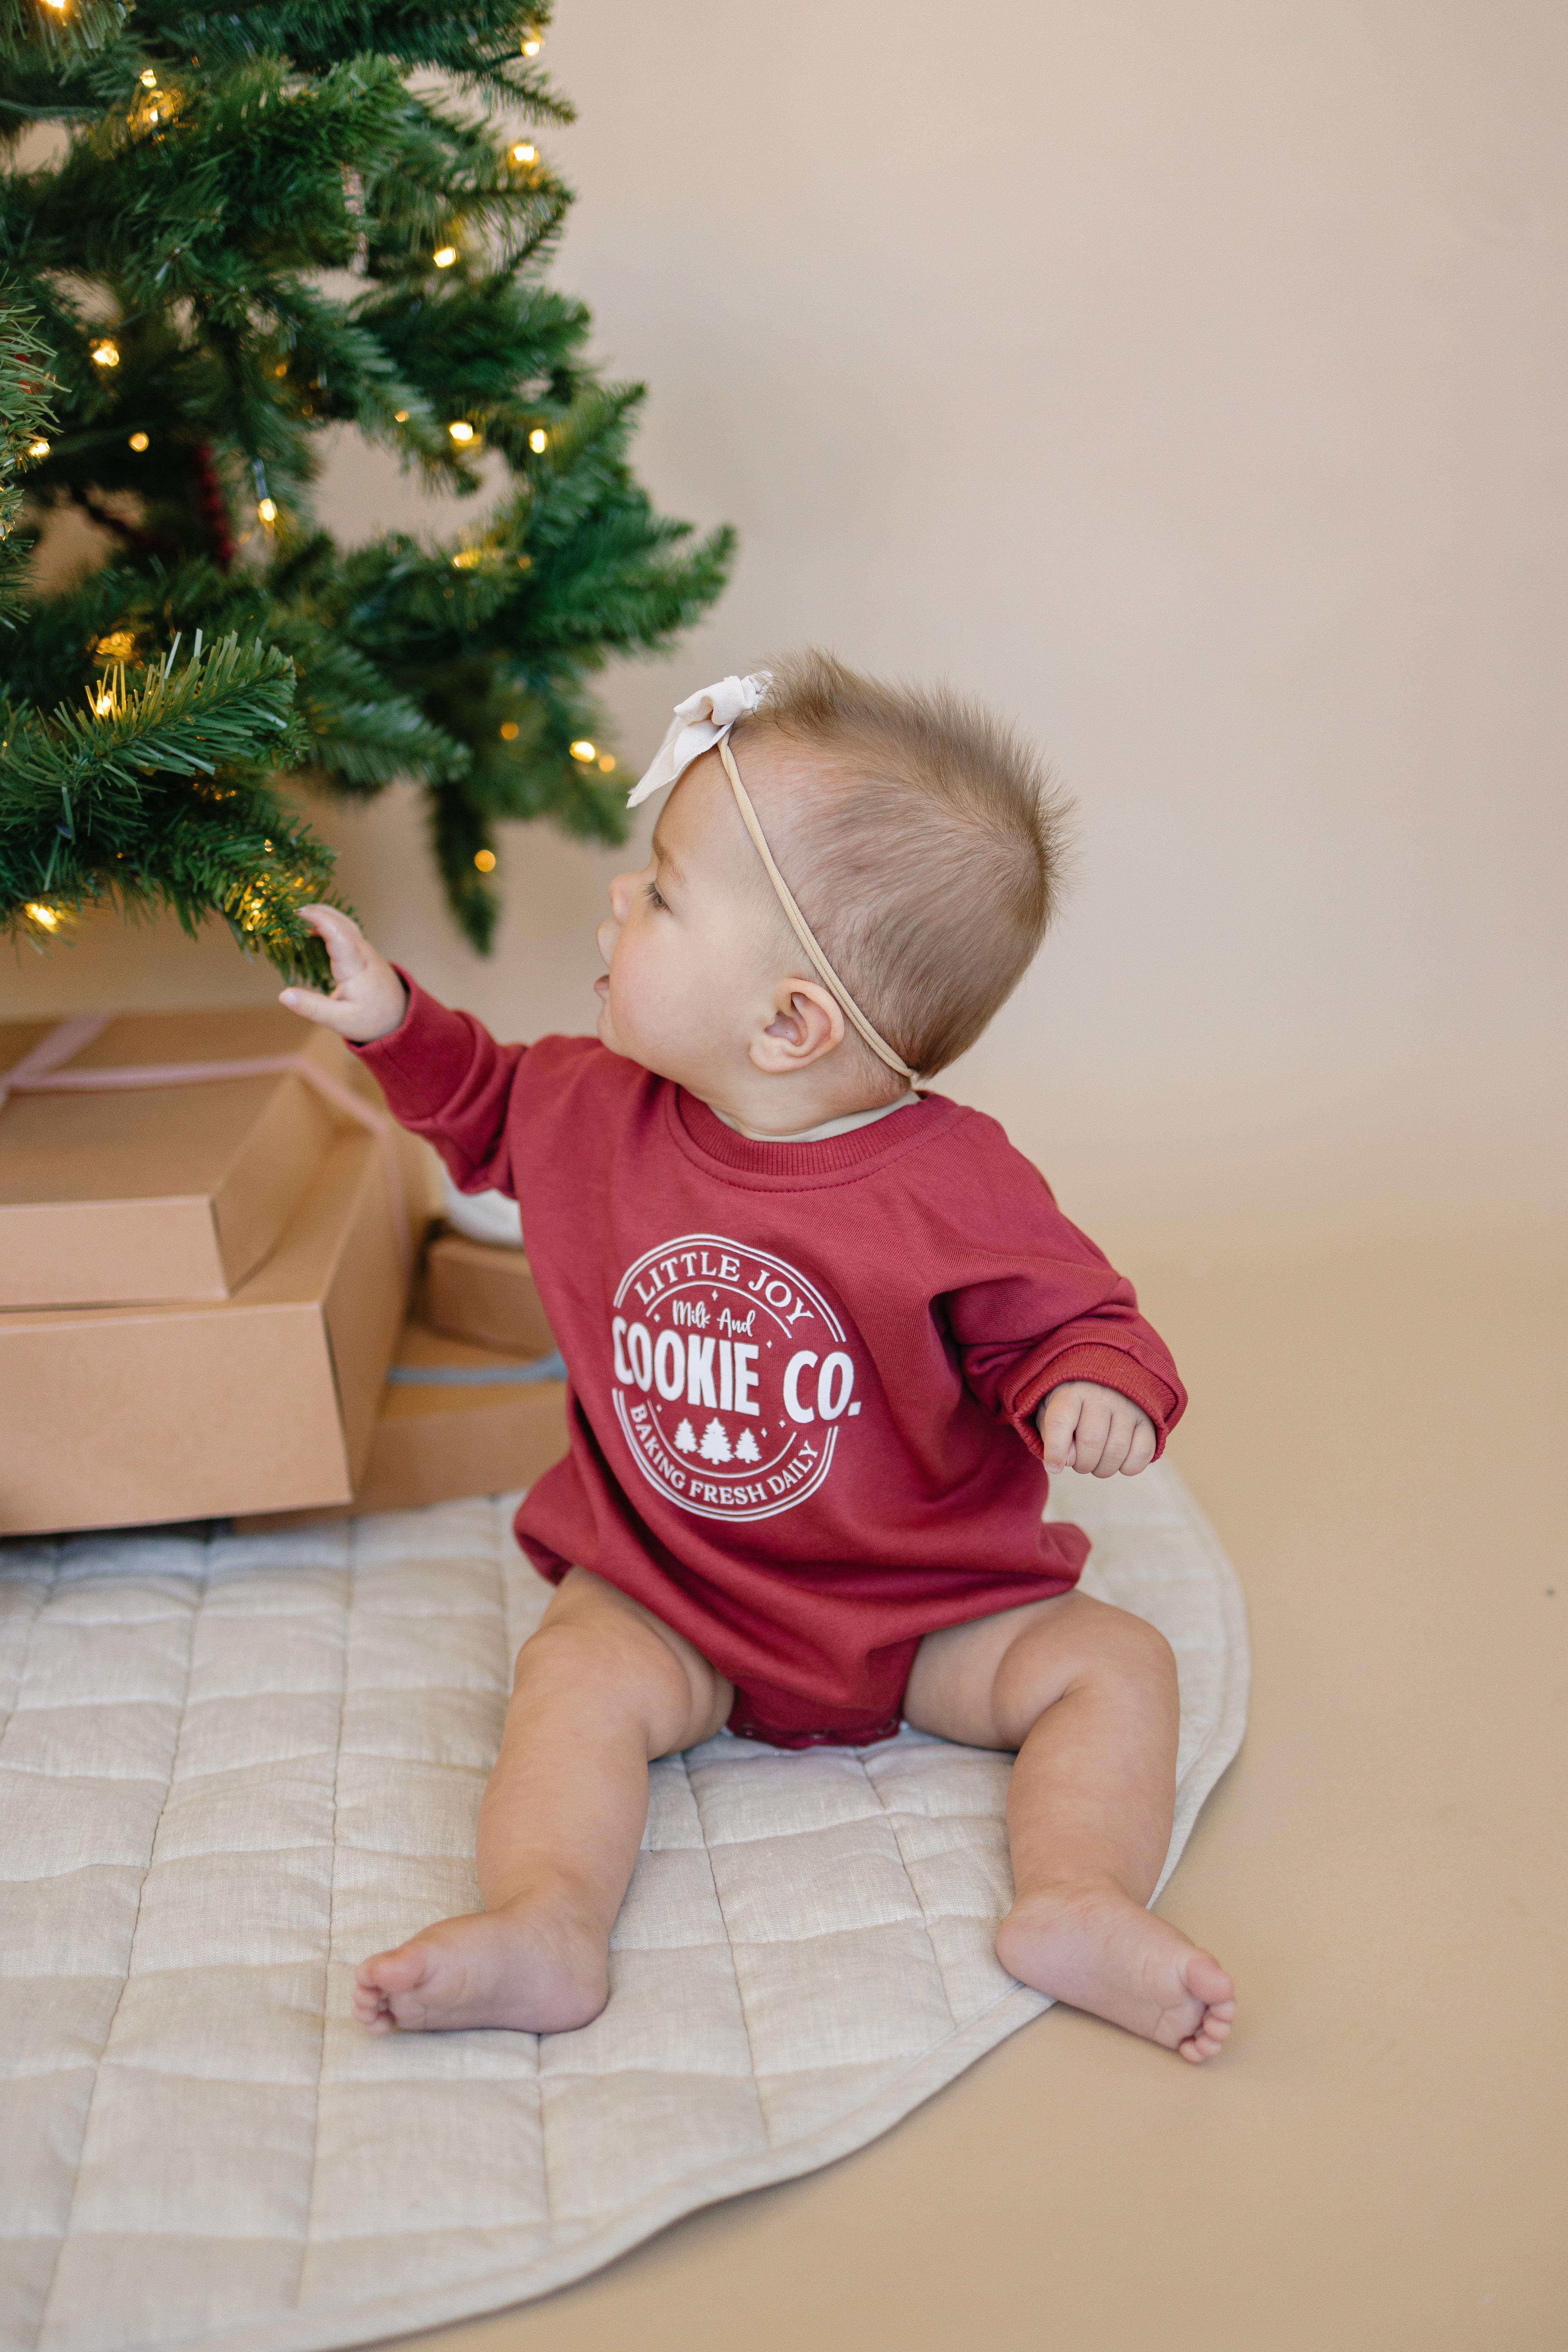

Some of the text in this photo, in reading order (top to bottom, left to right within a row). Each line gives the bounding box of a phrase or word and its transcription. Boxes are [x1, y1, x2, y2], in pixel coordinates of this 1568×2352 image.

[634, 1252, 815, 1325] LITTLE JOY
[672, 1299, 756, 1338] Milk And
[612, 1316, 861, 1424] COOKIE CO.
[630, 1404, 818, 1505] BAKING FRESH DAILY
